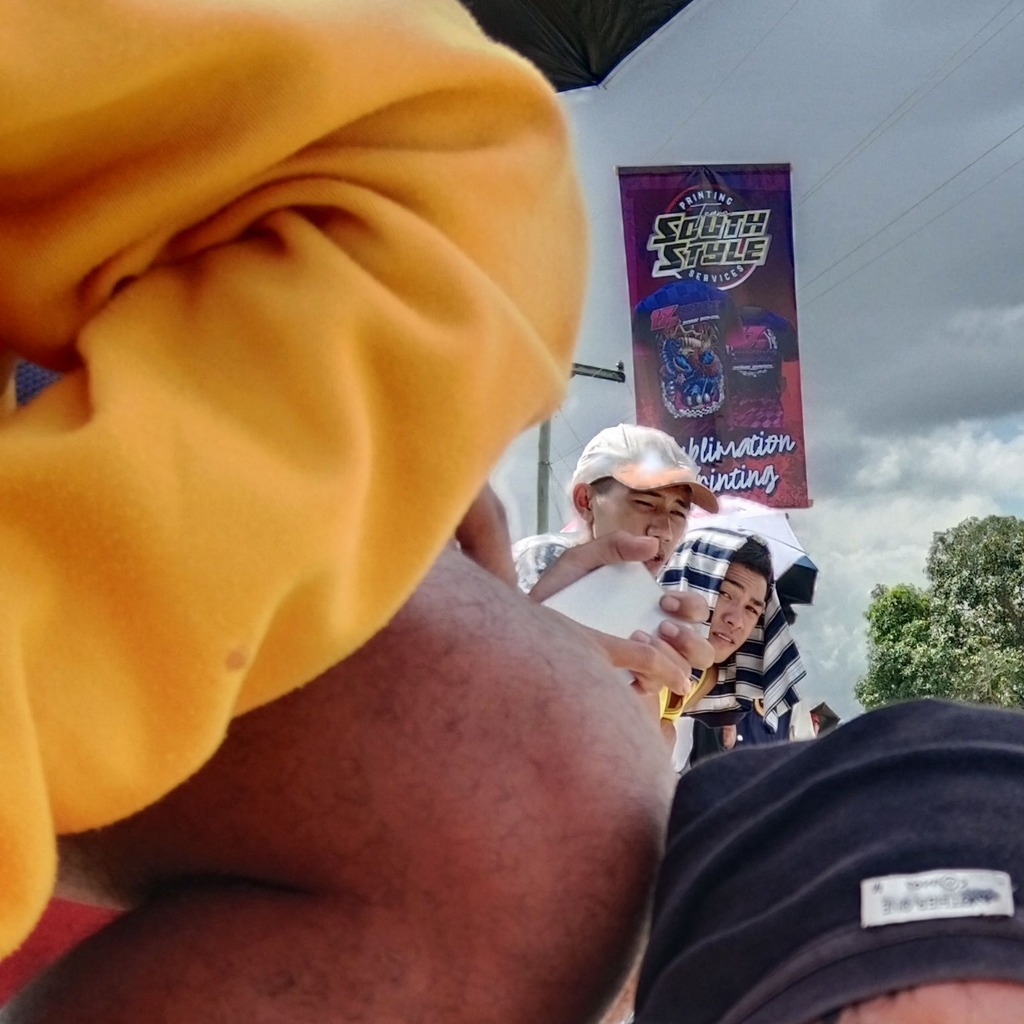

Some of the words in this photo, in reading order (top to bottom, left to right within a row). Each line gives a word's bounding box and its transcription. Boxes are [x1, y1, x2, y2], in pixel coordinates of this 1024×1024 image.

[679, 190, 733, 211] PRINTING
[649, 210, 770, 247] SOUTH
[654, 237, 770, 276] STYLE
[689, 265, 744, 282] SERVICES
[683, 431, 795, 464] blimation
[698, 465, 779, 494] rinting
